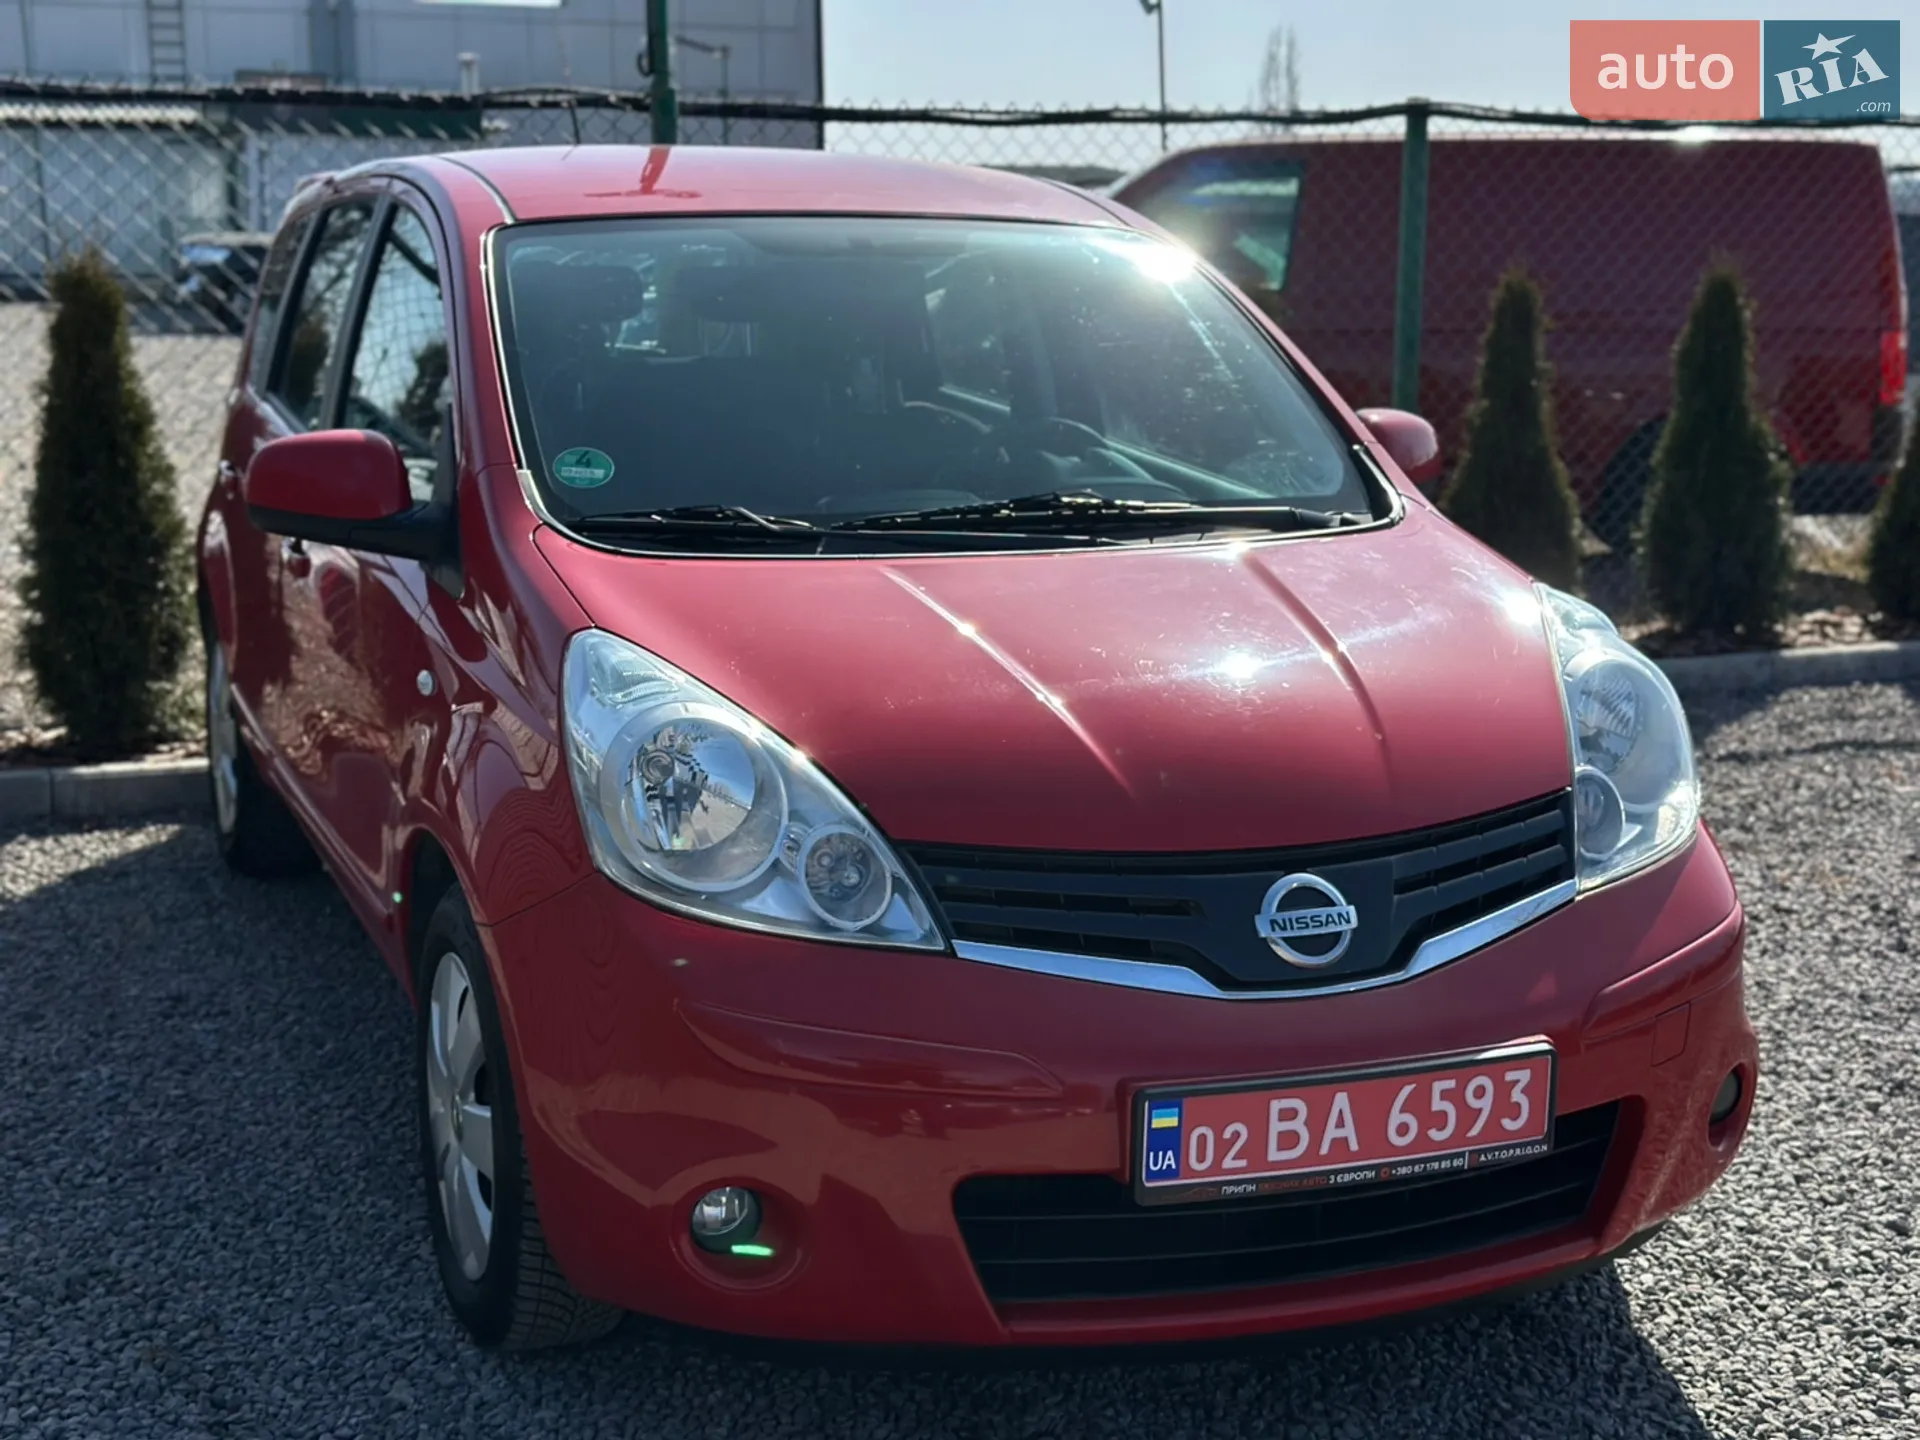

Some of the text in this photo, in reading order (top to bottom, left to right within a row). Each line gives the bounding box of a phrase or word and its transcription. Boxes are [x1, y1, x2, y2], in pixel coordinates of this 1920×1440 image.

[575, 450, 592, 468] 4
[1269, 911, 1351, 932] NISSAN
[1188, 1068, 1531, 1171] 02 BA 6593
[1149, 1150, 1176, 1171] UA
